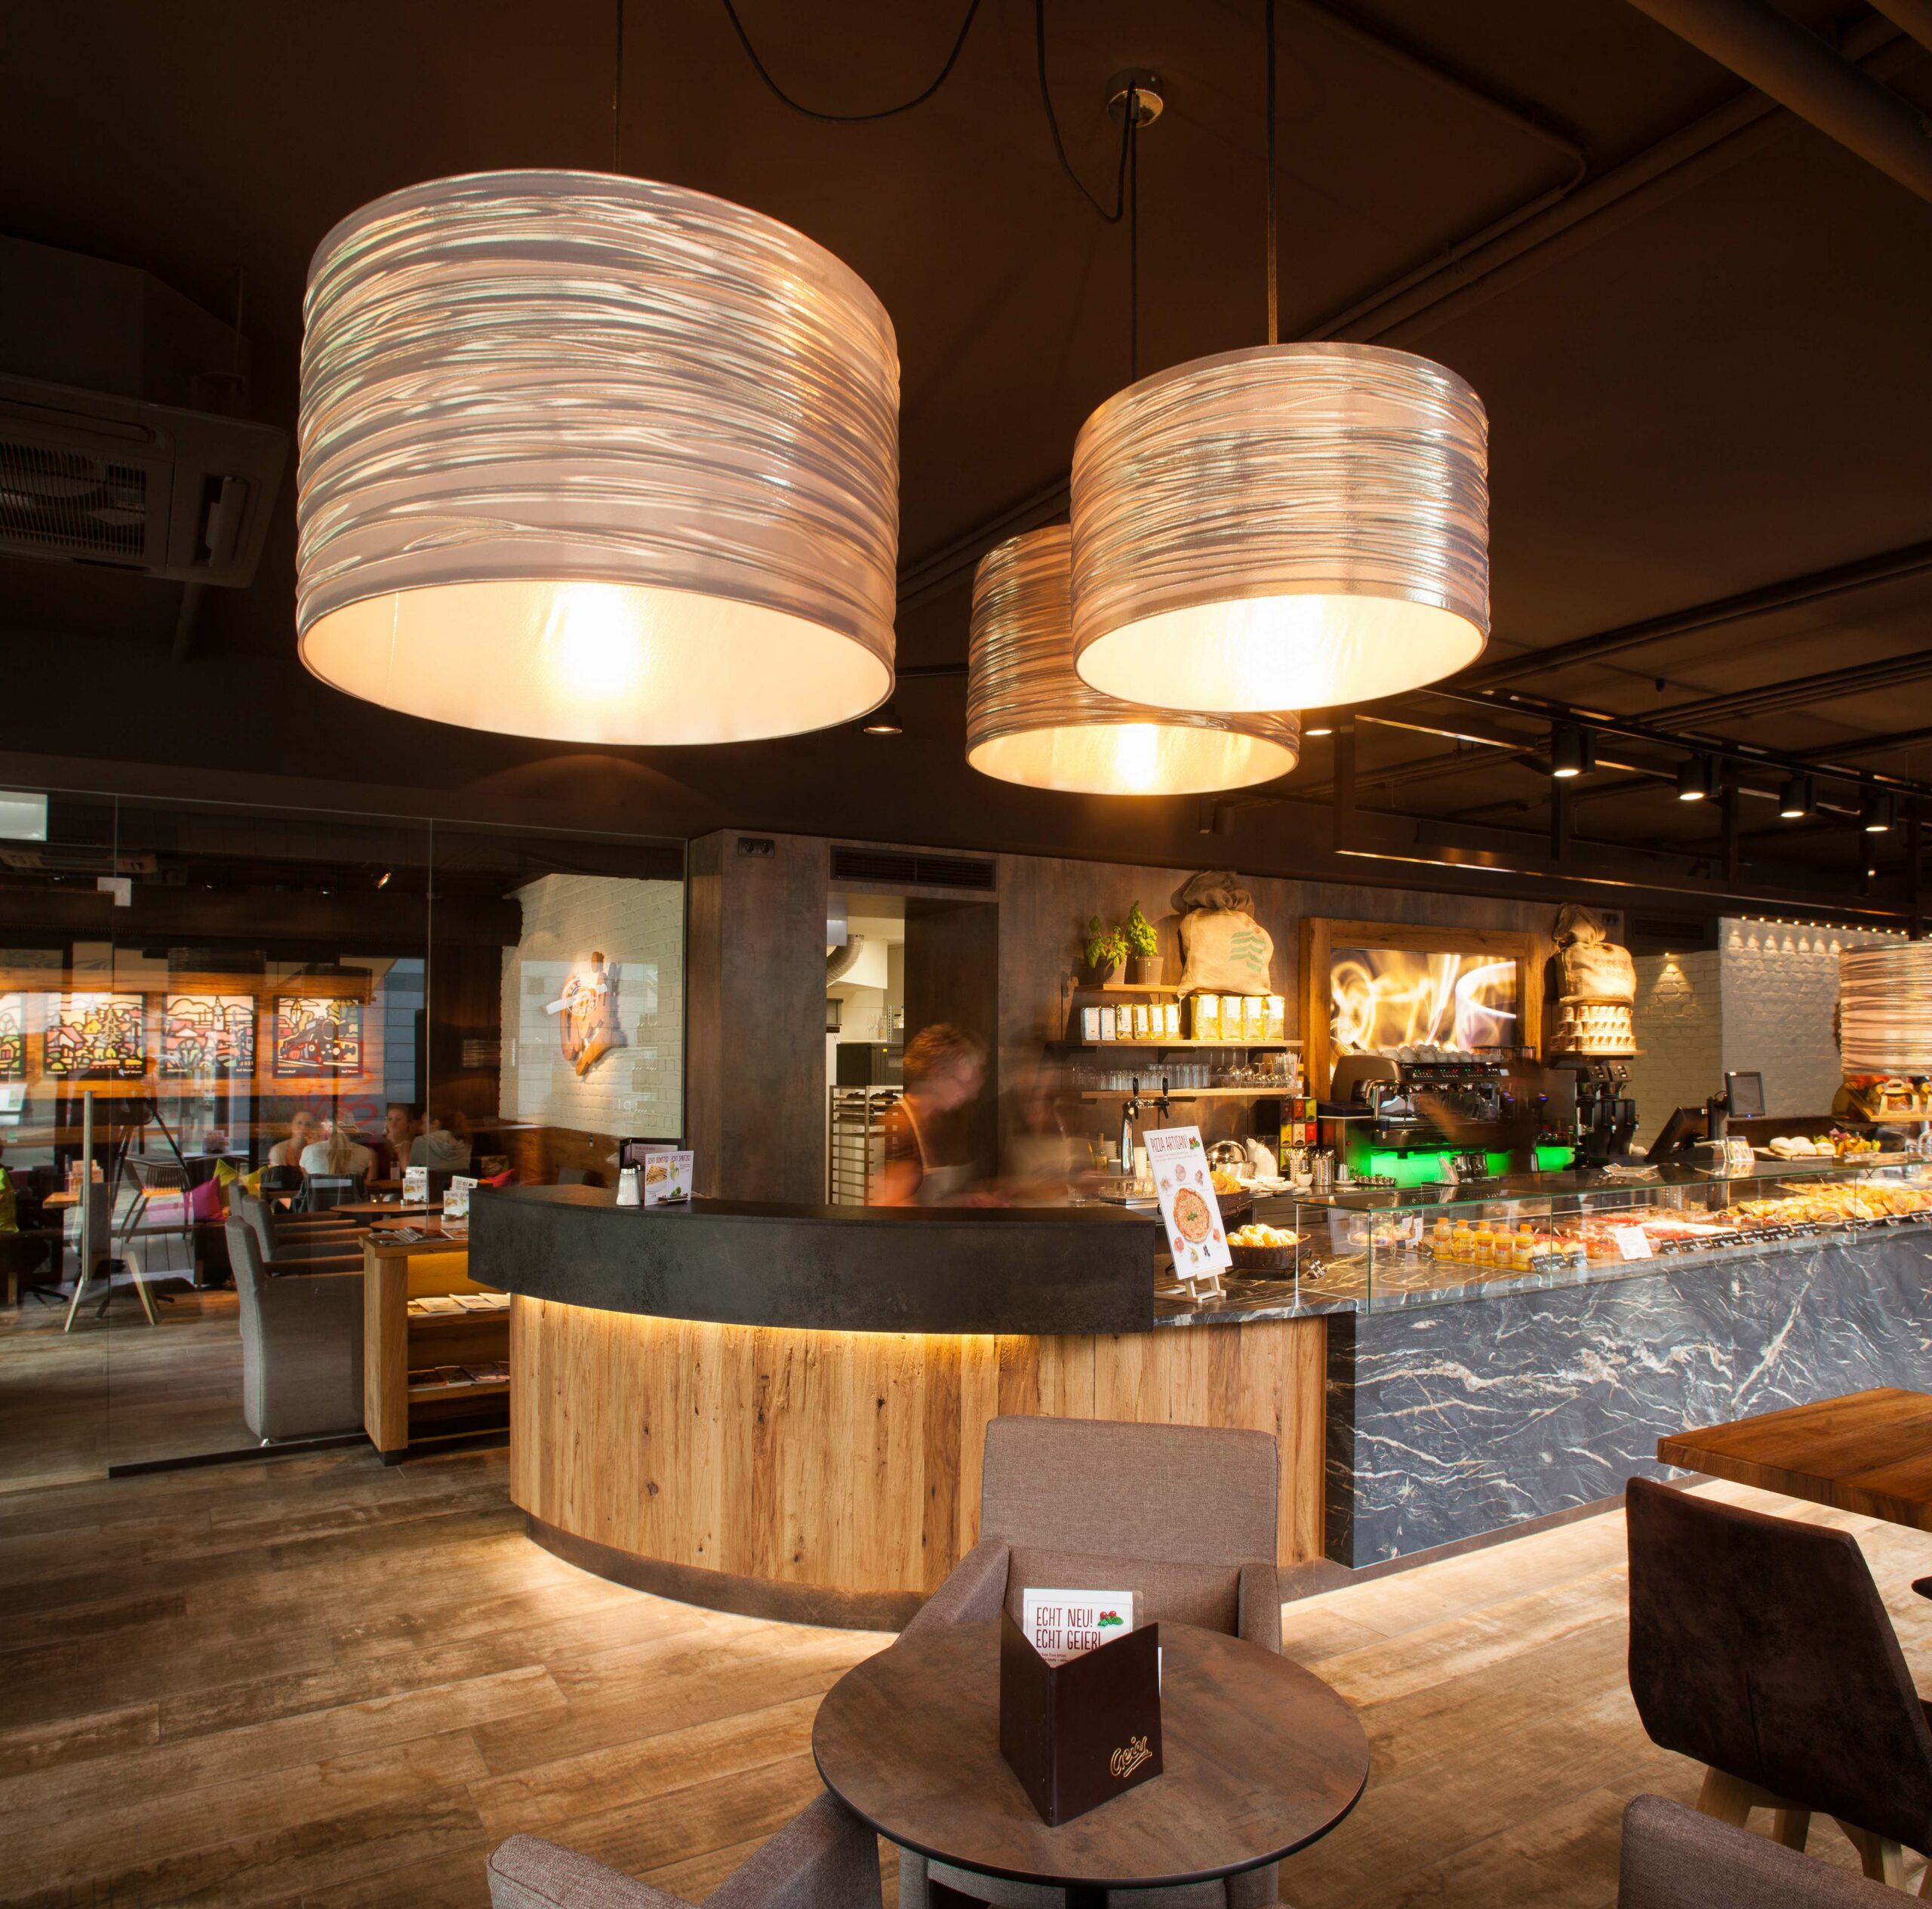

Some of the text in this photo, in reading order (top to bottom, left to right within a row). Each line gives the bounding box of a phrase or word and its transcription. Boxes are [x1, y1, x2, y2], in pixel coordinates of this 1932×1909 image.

[1150, 1137, 1166, 1153] PIZZA
[1036, 1606, 1093, 1628] ECHT NEU!
[1036, 1629, 1063, 1649] ECHT
